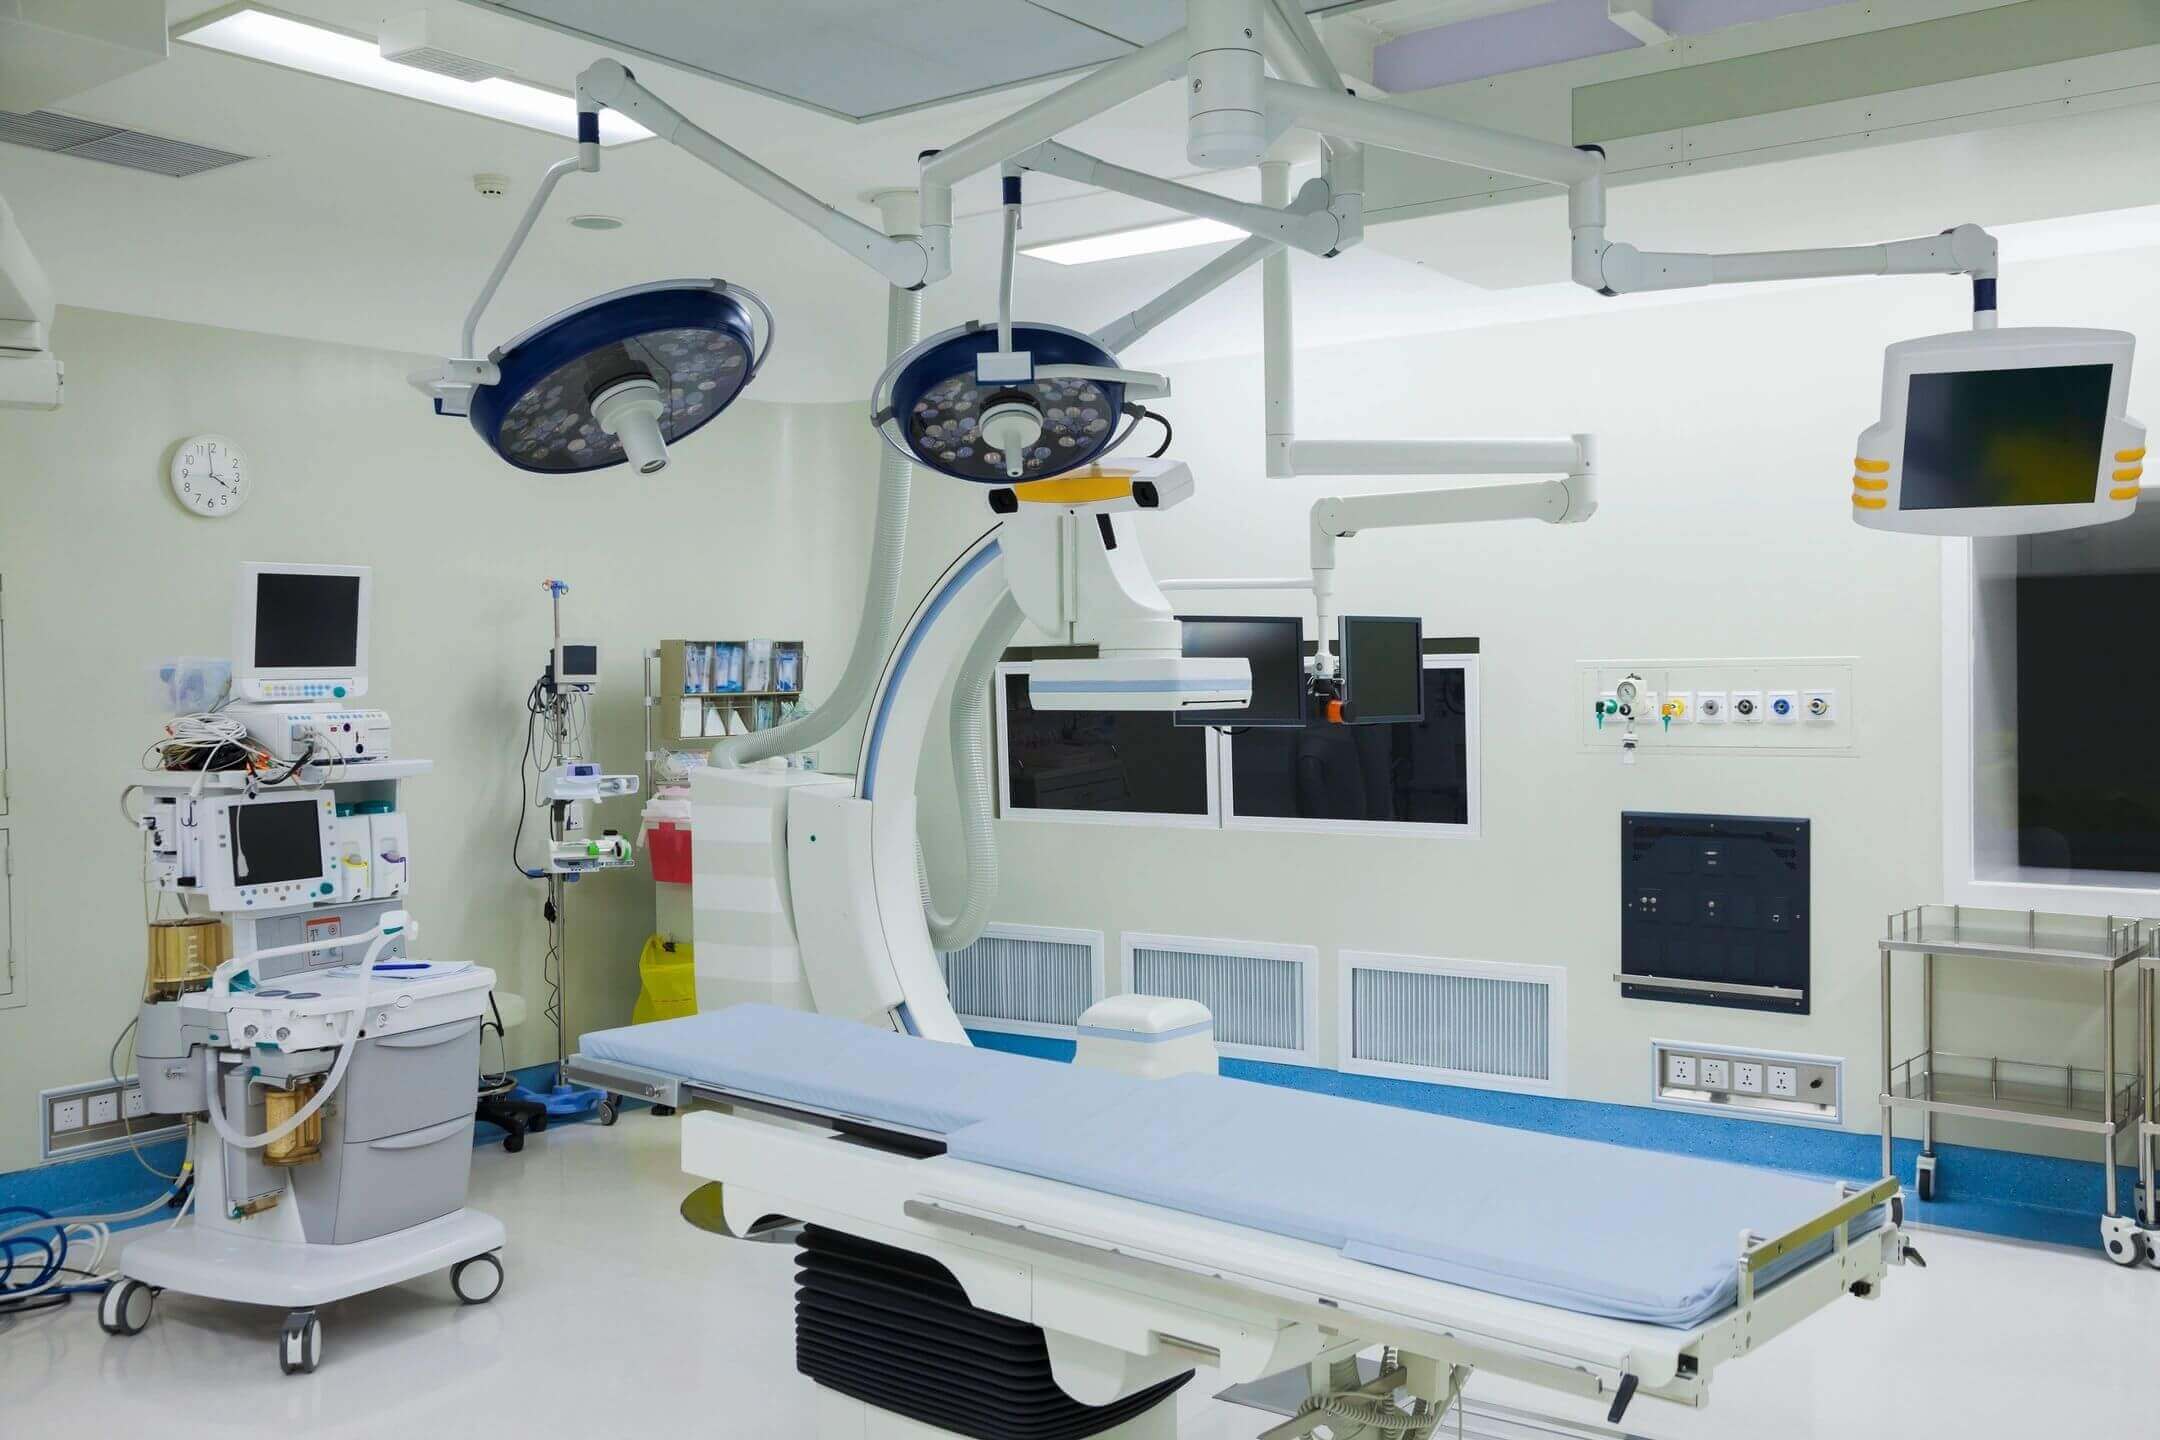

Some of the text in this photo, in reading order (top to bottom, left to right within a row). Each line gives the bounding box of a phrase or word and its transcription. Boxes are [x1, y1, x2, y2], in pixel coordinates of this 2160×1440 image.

[196, 444, 204, 456] 11
[185, 454, 194, 465] 10
[232, 458, 239, 469] 2
[182, 468, 189, 479] 9
[234, 472, 240, 483] 3
[184, 482, 191, 493] 8
[231, 486, 238, 495] 4
[194, 493, 202, 504] 7
[207, 498, 214, 508] 6
[220, 494, 228, 505] 5
